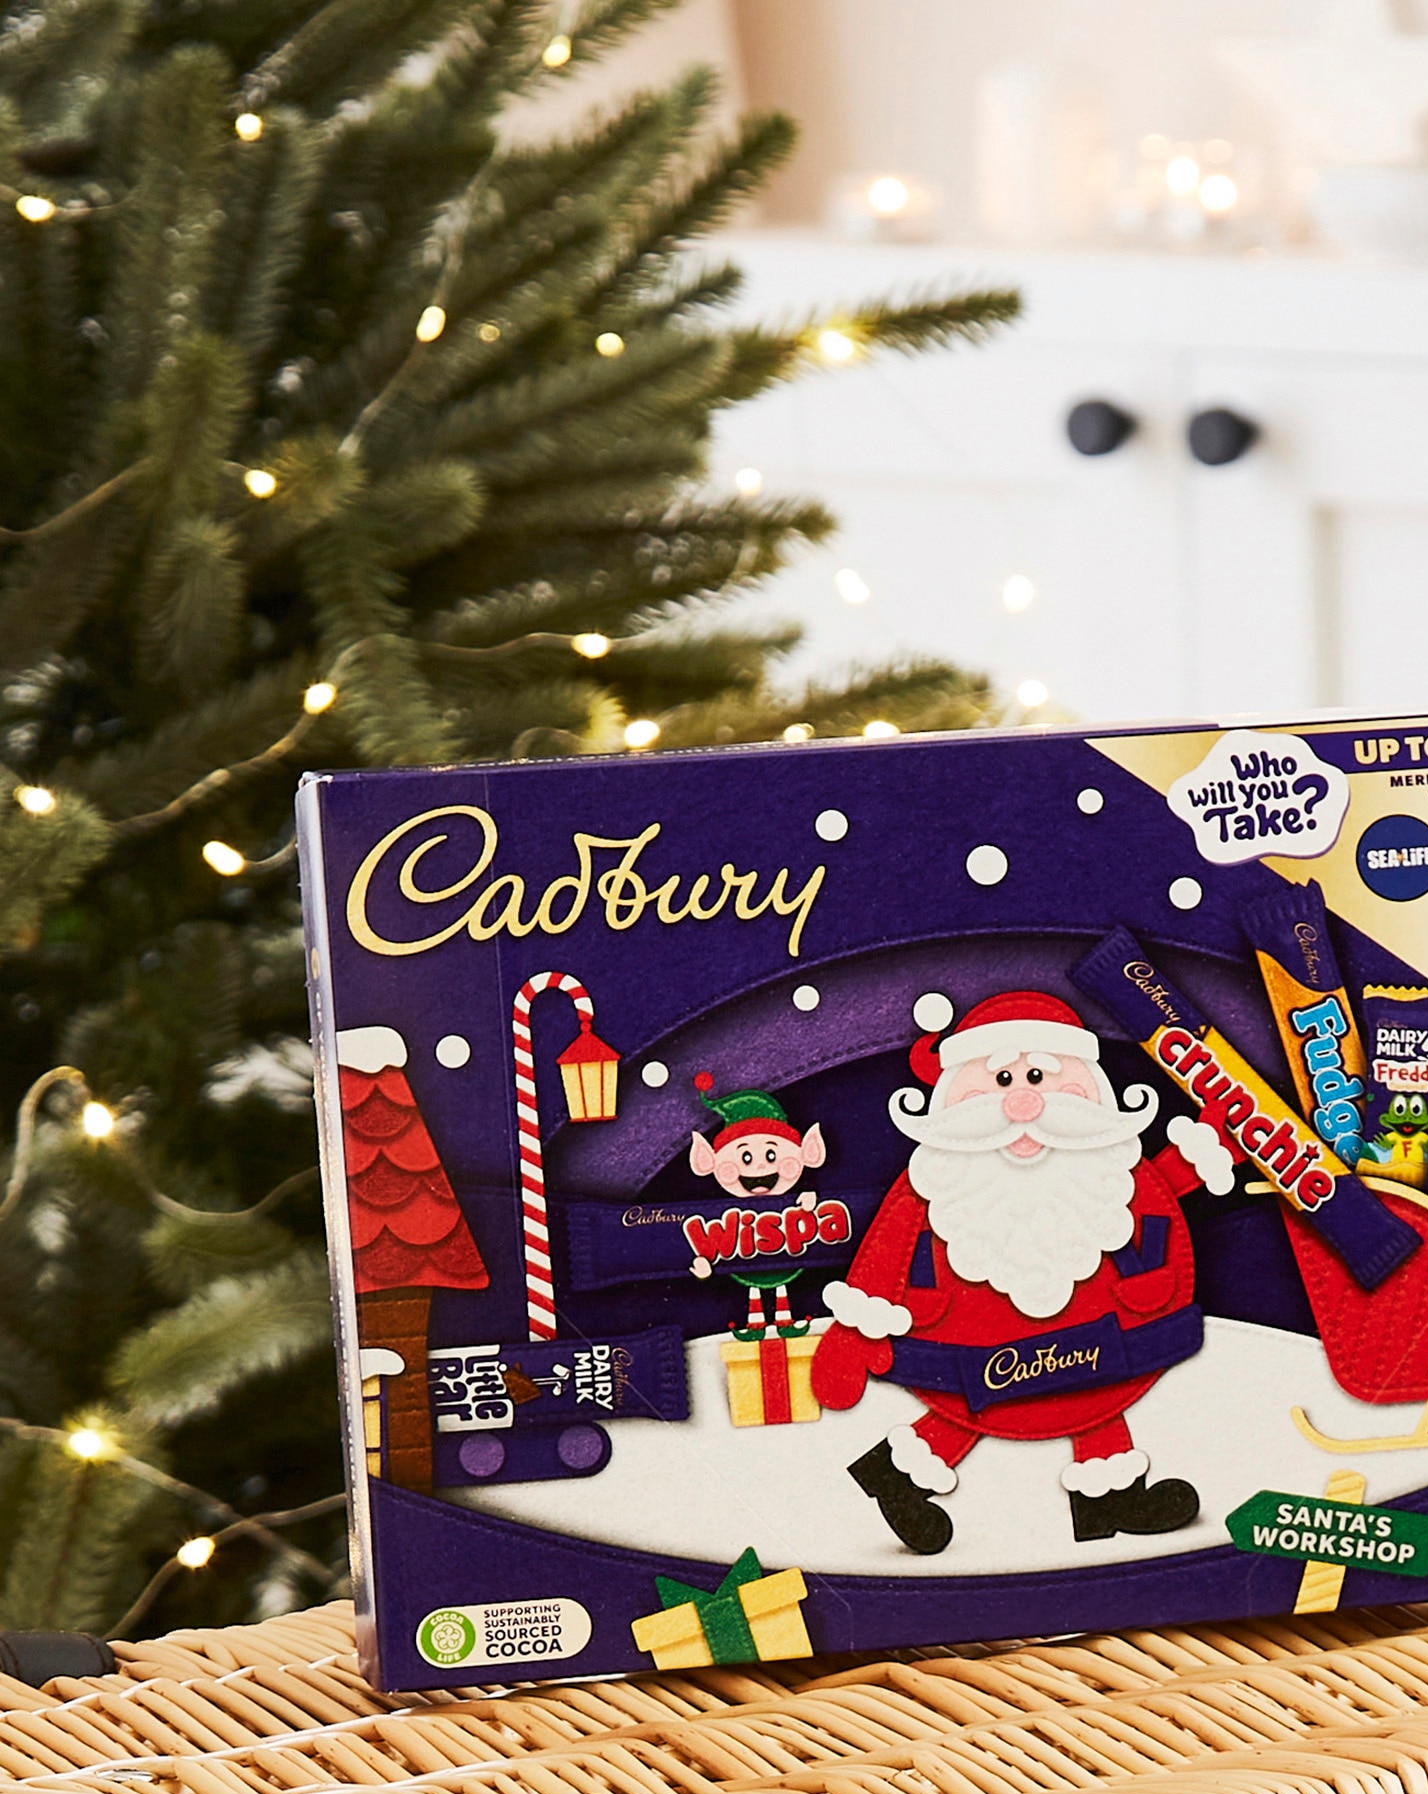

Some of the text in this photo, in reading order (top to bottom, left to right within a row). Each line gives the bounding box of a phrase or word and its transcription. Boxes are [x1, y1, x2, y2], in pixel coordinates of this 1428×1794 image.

[1231, 751, 1297, 780] Who
[1353, 738, 1400, 765] UP
[1188, 780, 1289, 809] will you
[346, 805, 826, 956] Cadbury
[1294, 922, 1321, 985] Cadbury
[1123, 961, 1181, 1025] Cadbury
[1377, 1028, 1428, 1043] DAIRY
[1377, 1042, 1417, 1057] MILK
[1292, 997, 1365, 1167] Fudge
[621, 1200, 851, 1264] Cadbury Wispa
[573, 1352, 594, 1404] MILK
[591, 1344, 614, 1411] DAIRY
[983, 1343, 1101, 1390] Cadbury
[1276, 1503, 1392, 1537] SANTA'S
[1253, 1525, 1416, 1564] WORKSHOP
[484, 1604, 561, 1618] SUPPORTING
[485, 1614, 561, 1628] SUSTAINABLY
[485, 1625, 562, 1641] SOURCED
[486, 1639, 563, 1658] COCOA
